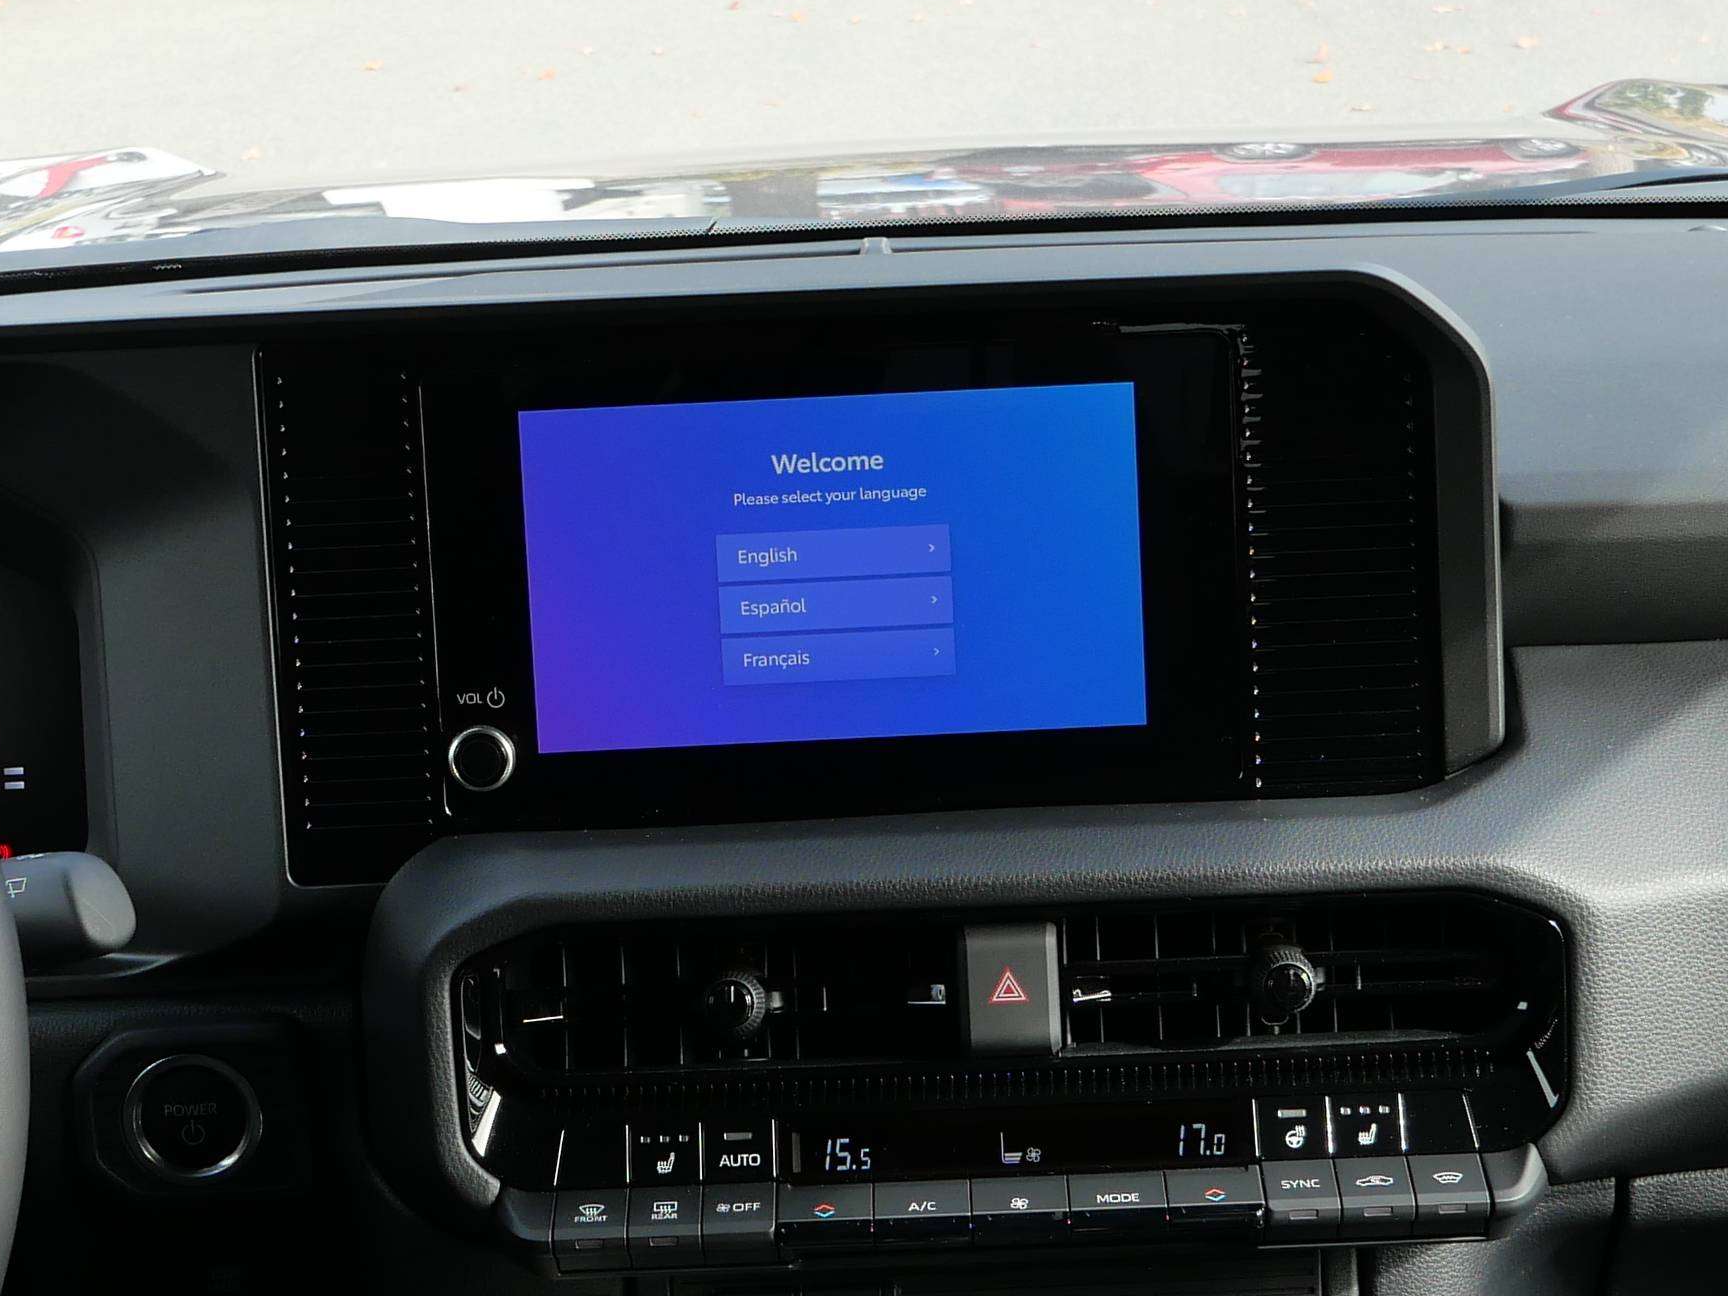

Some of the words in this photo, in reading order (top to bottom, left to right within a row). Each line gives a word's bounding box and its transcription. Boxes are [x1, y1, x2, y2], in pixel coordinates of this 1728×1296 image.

[771, 452, 885, 475] Welcome
[733, 493, 779, 506] Please
[781, 491, 823, 504] select
[825, 490, 856, 504] your
[859, 486, 927, 500] language
[738, 547, 797, 567] English
[740, 598, 807, 618] Español
[743, 650, 810, 669] Français
[456, 693, 483, 704] VOL
[163, 1103, 218, 1116] POWER
[1178, 1123, 1226, 1157] 17.0
[719, 1153, 761, 1167] AUTO
[824, 1137, 871, 1172] 15.5
[1280, 1178, 1321, 1190] SYNC
[1096, 1192, 1140, 1204] MODE
[732, 1202, 761, 1212] OFF
[908, 1201, 937, 1212] A/C
[573, 1214, 609, 1223] FRONT
[651, 1211, 679, 1220] REAR
